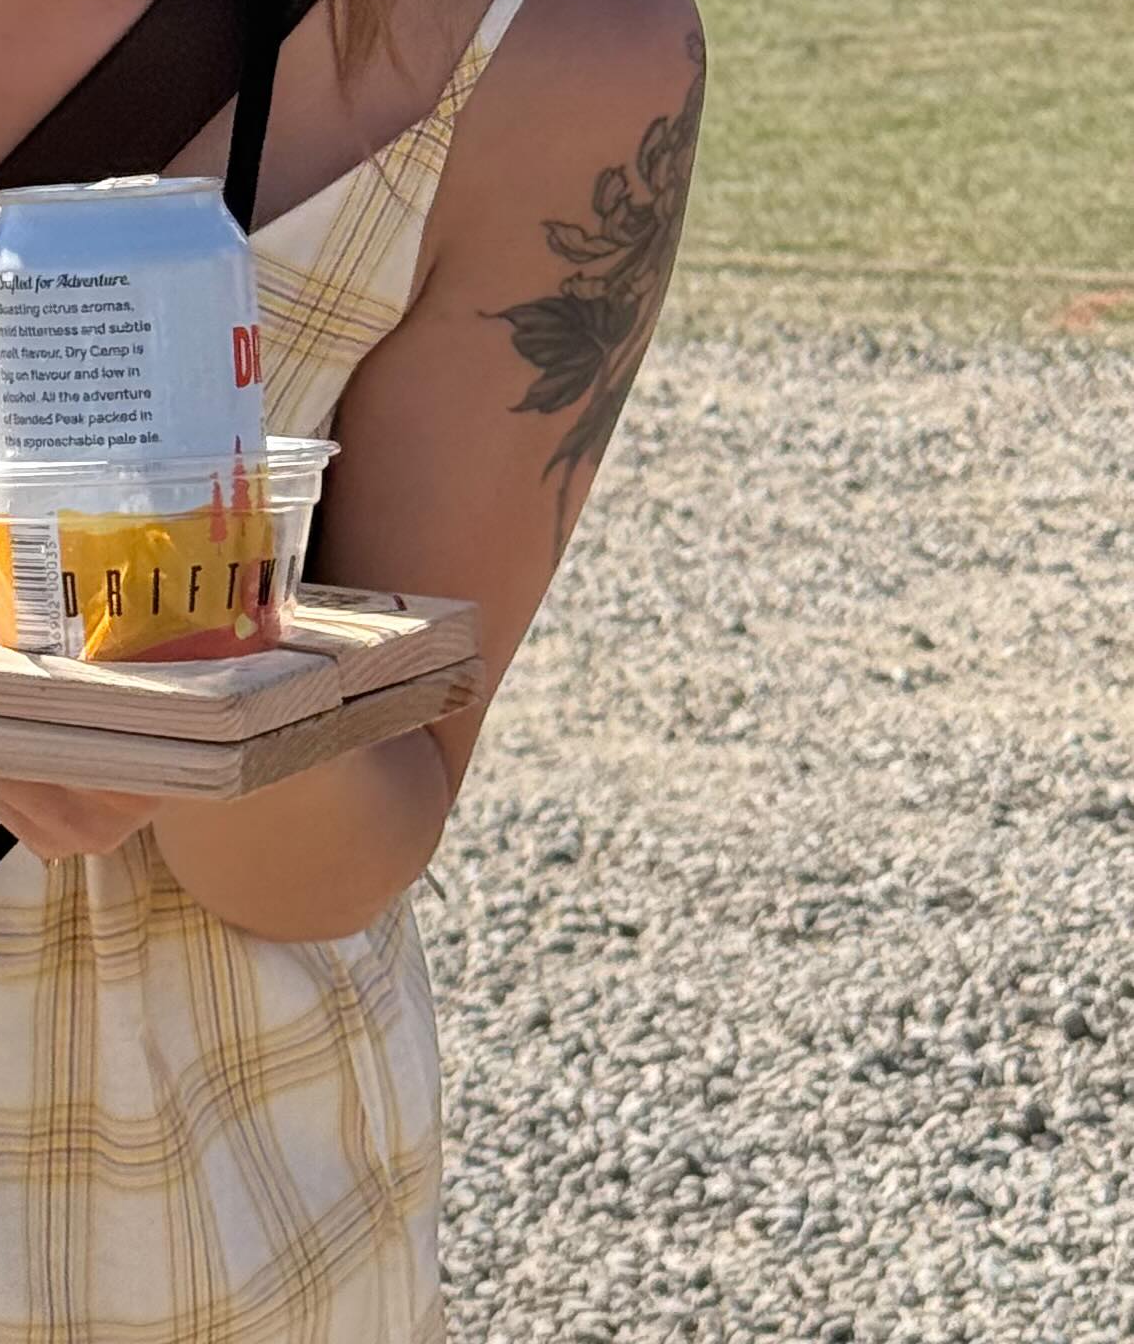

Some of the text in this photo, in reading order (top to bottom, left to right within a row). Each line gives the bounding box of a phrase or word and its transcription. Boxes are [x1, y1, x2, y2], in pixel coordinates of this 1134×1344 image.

[35, 274, 55, 293] for
[42, 303, 79, 315] citrus
[18, 325, 79, 338] bitterness
[80, 322, 106, 335] and
[108, 320, 152, 334] subtle
[65, 345, 87, 362] Dry
[89, 344, 130, 359] Camp
[132, 343, 144, 355] is
[15, 371, 29, 382] on
[30, 369, 72, 382] flavour
[73, 367, 99, 381] and
[101, 366, 126, 378] low
[128, 366, 140, 378] in
[41, 391, 56, 403] All
[58, 391, 80, 404] the
[82, 388, 152, 403] adventure
[3, 413, 12, 425] of
[55, 413, 85, 426] Peak
[88, 410, 138, 427] packed
[140, 409, 153, 422] in
[23, 435, 106, 451] approachable
[108, 433, 137, 449] pale
